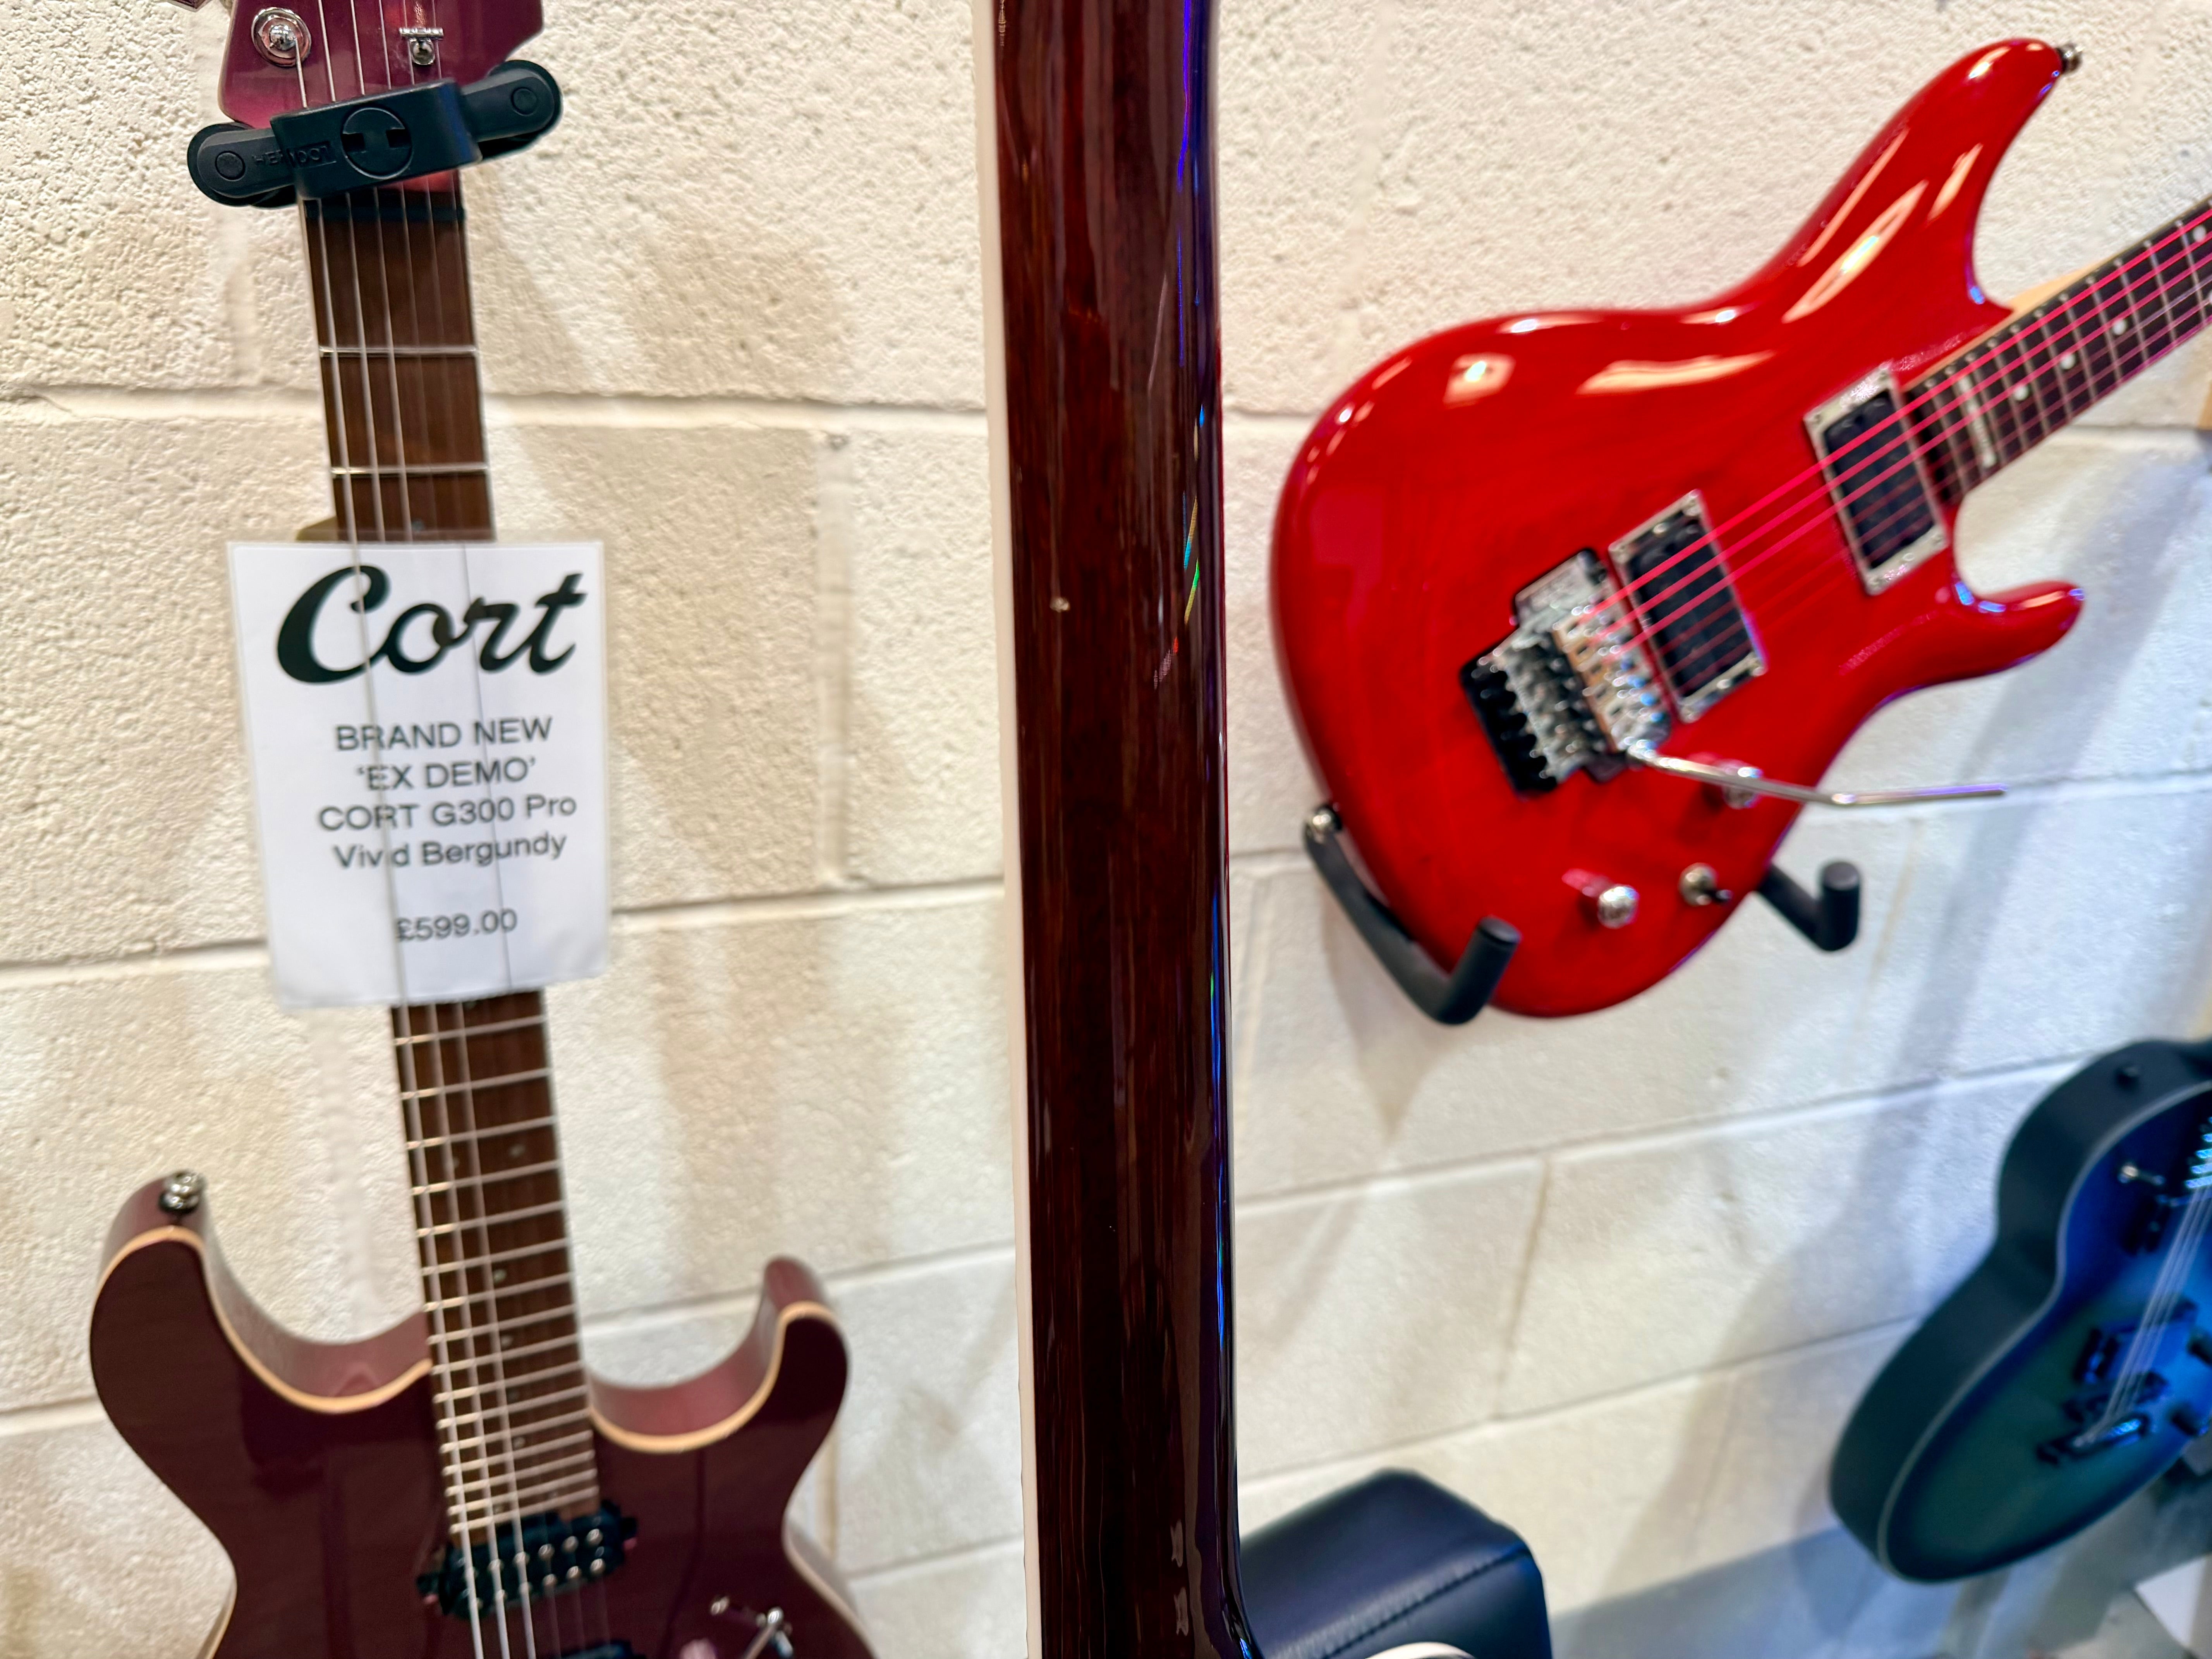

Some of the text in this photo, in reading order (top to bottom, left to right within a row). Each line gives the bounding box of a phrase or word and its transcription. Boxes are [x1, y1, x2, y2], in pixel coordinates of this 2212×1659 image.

[277, 565, 587, 685] Cort
[336, 716, 552, 750] BRAND NEW
[319, 793, 577, 831] CORT G300 Pro
[333, 831, 567, 868] Vivd Bergundy
[395, 908, 517, 942] £599.00
